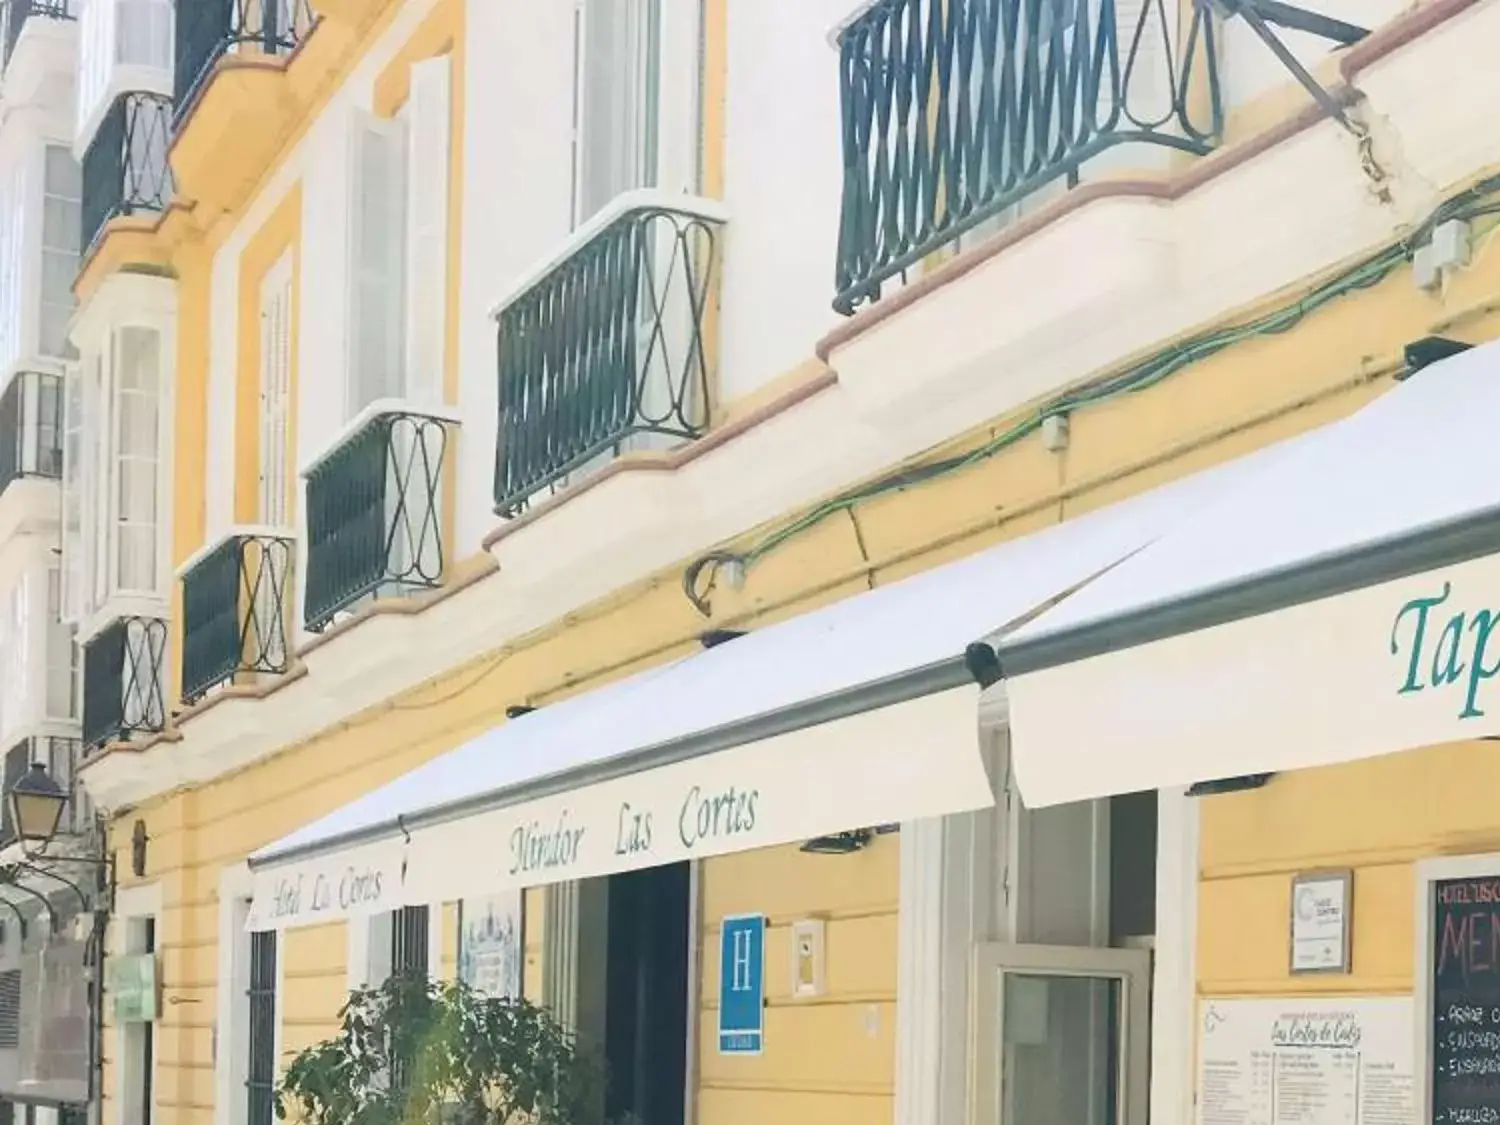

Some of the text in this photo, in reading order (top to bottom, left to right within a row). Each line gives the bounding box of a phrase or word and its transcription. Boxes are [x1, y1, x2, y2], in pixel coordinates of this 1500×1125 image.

[615, 802, 653, 855] Las
[679, 786, 760, 848] Cortes
[731, 929, 753, 992] H
